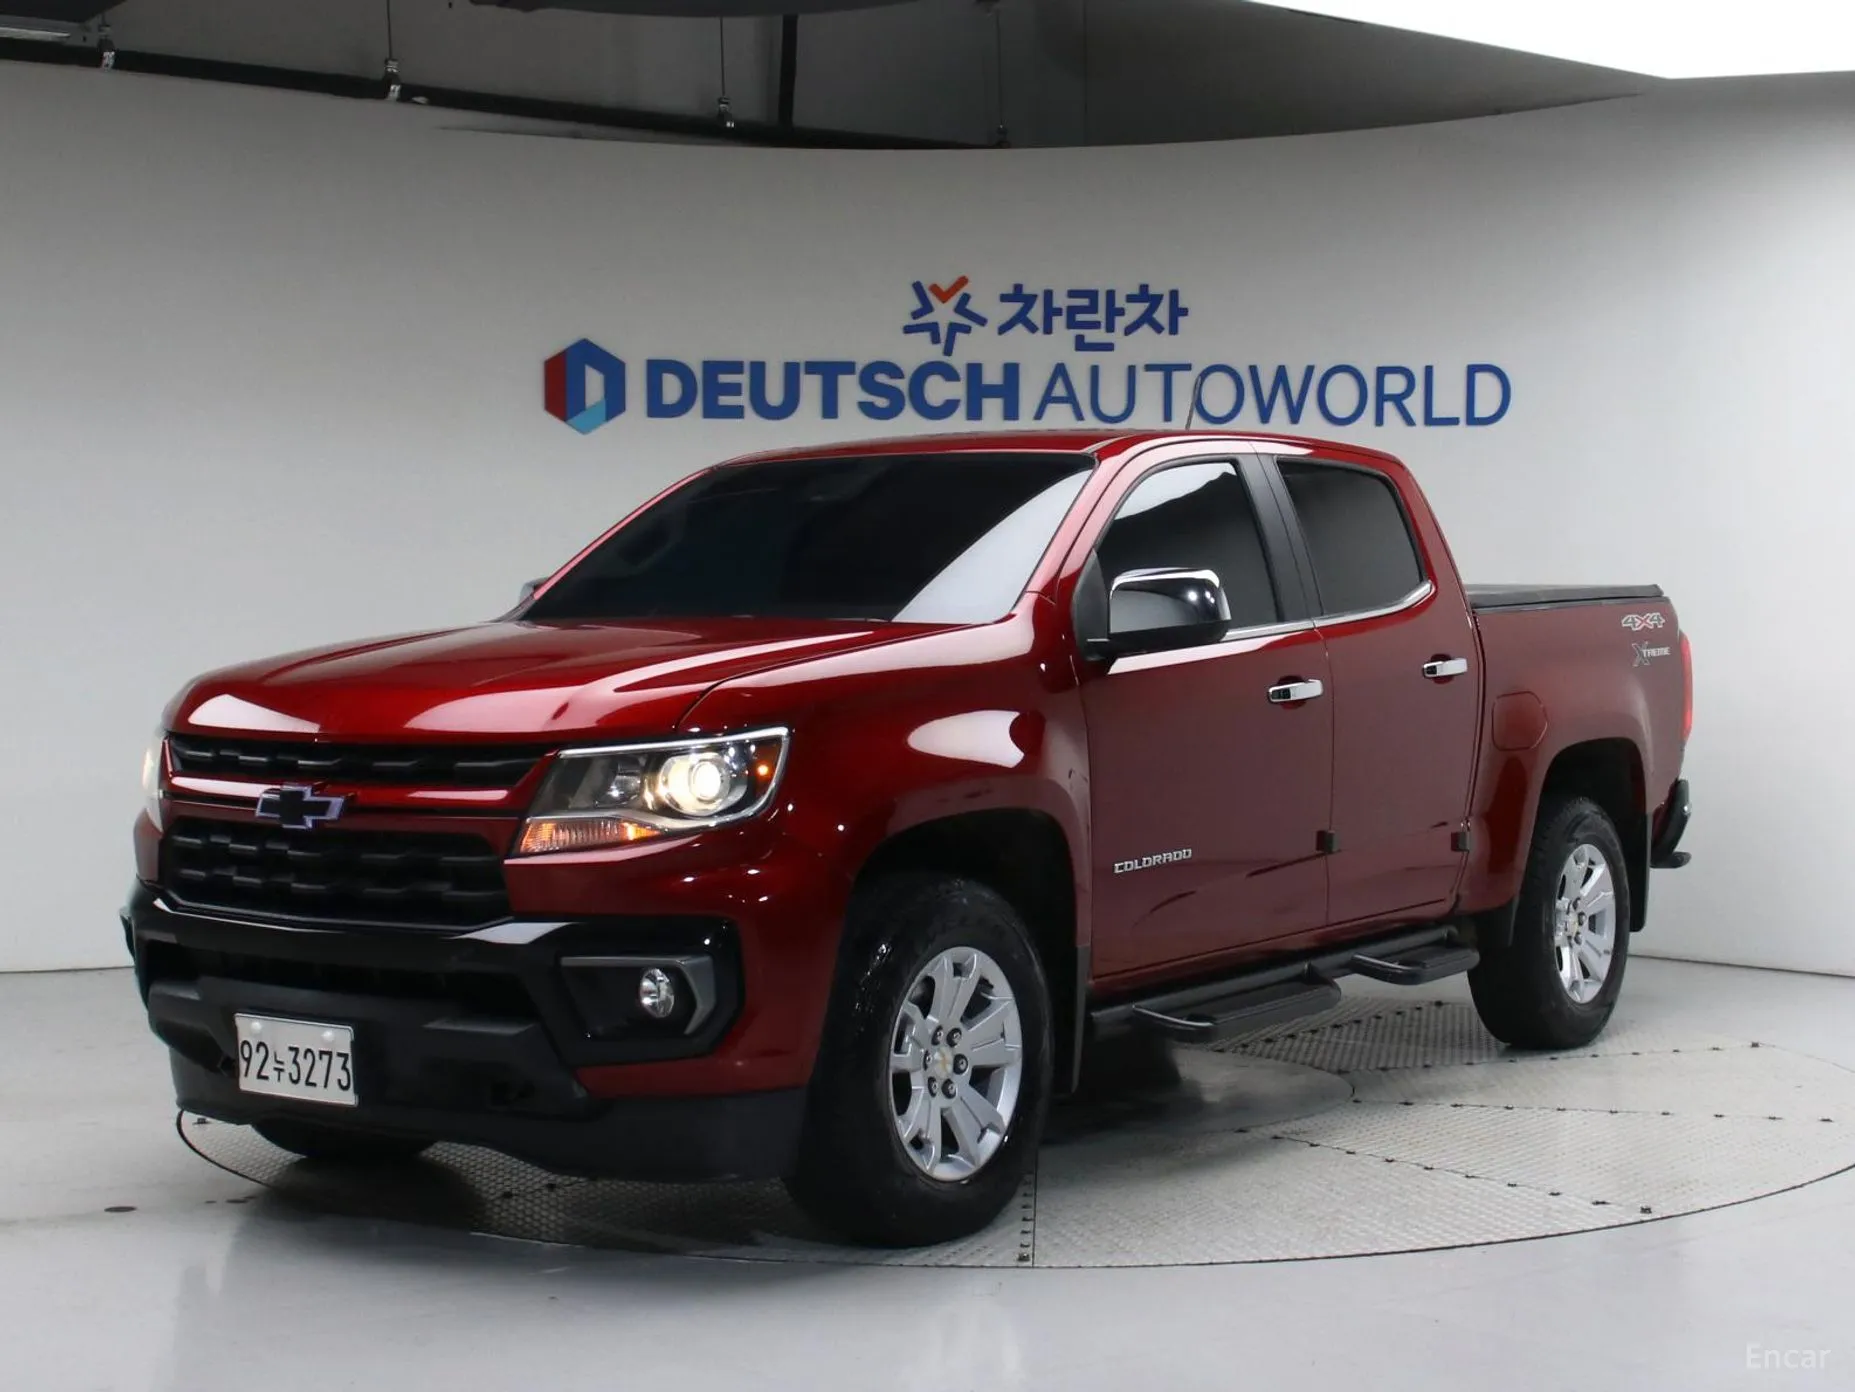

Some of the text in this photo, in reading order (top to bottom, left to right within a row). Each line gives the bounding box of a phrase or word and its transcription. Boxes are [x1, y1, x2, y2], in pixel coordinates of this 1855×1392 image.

[998, 284, 1188, 352] 차란차
[647, 360, 1512, 427] DEUTSCH AUTOWORLD
[1114, 848, 1193, 874] COLORADO
